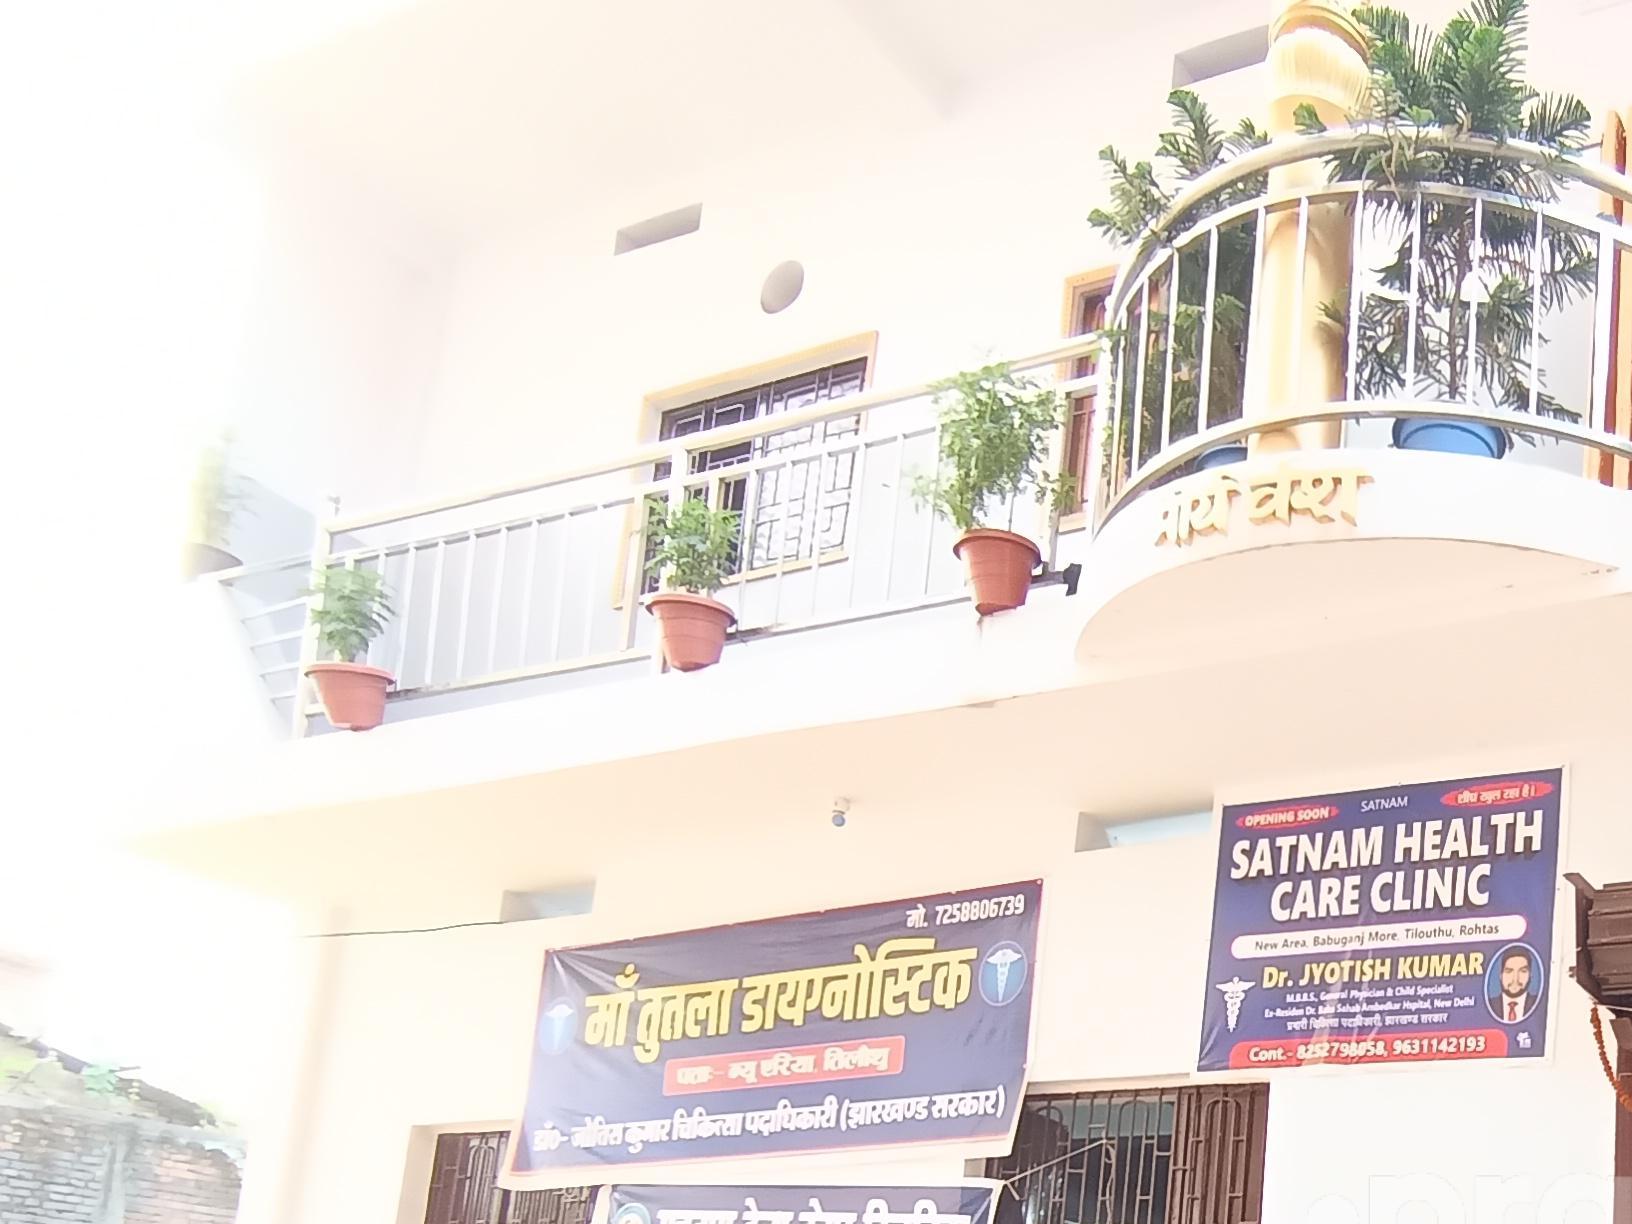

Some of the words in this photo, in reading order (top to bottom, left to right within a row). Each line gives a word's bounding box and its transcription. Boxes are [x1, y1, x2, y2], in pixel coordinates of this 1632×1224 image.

[1245, 811, 1295, 826] OPENING
[1296, 807, 1329, 821] SOON
[1361, 796, 1408, 812] SATNAM
[1230, 826, 1384, 879] SATNAM
[1394, 810, 1543, 863] HEALTH
[1271, 875, 1360, 922] CARE
[1370, 864, 1491, 913] CLINIC
[934, 894, 1025, 926] 7258806739
[1255, 941, 1278, 951] New
[1313, 935, 1364, 948] Babuganj
[1405, 927, 1454, 939] Tilouthu,
[1460, 924, 1499, 935] Rohtas
[1262, 967, 1293, 987] Dr.
[1299, 958, 1390, 986] JYOTISH
[1398, 953, 1483, 979] KUMAR
[583, 964, 639, 1049] माँ
[741, 938, 978, 1033] डायग्नोस्टिक
[1395, 987, 1415, 996] Child
[1417, 985, 1453, 996] Specialist
[1434, 998, 1451, 1008] New
[1454, 997, 1474, 1007] Delhi
[1393, 1036, 1486, 1054] 9631142193
